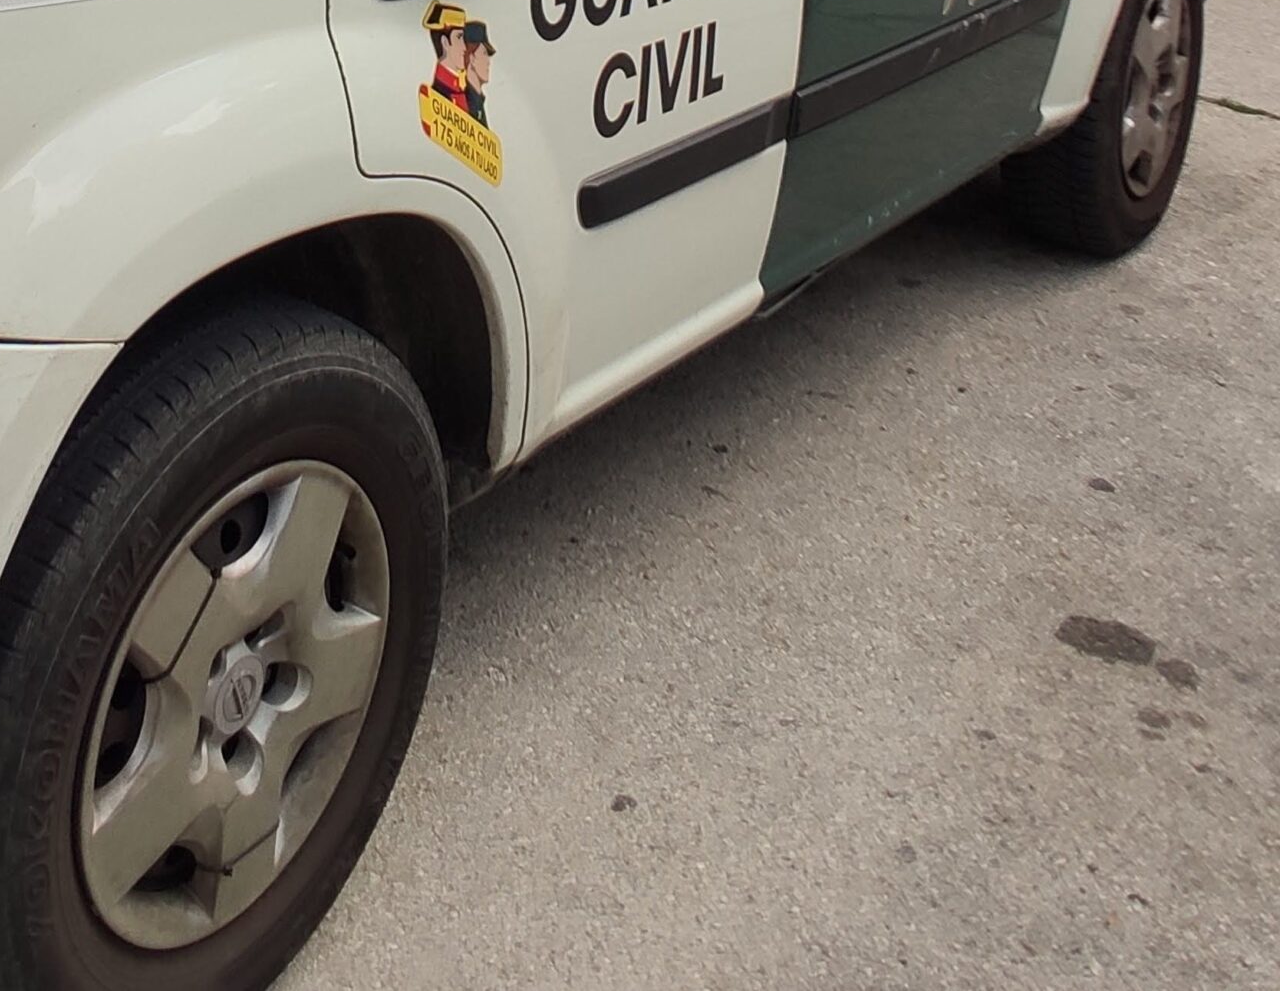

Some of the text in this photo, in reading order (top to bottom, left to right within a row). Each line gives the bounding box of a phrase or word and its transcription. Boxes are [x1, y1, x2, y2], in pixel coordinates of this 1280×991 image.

[593, 22, 724, 139] CIVIL
[432, 99, 499, 159] GUARDIA CIVIL
[433, 119, 453, 147] 175
[471, 148, 475, 163] A
[476, 151, 483, 169] TU
[484, 158, 498, 180] LADO
